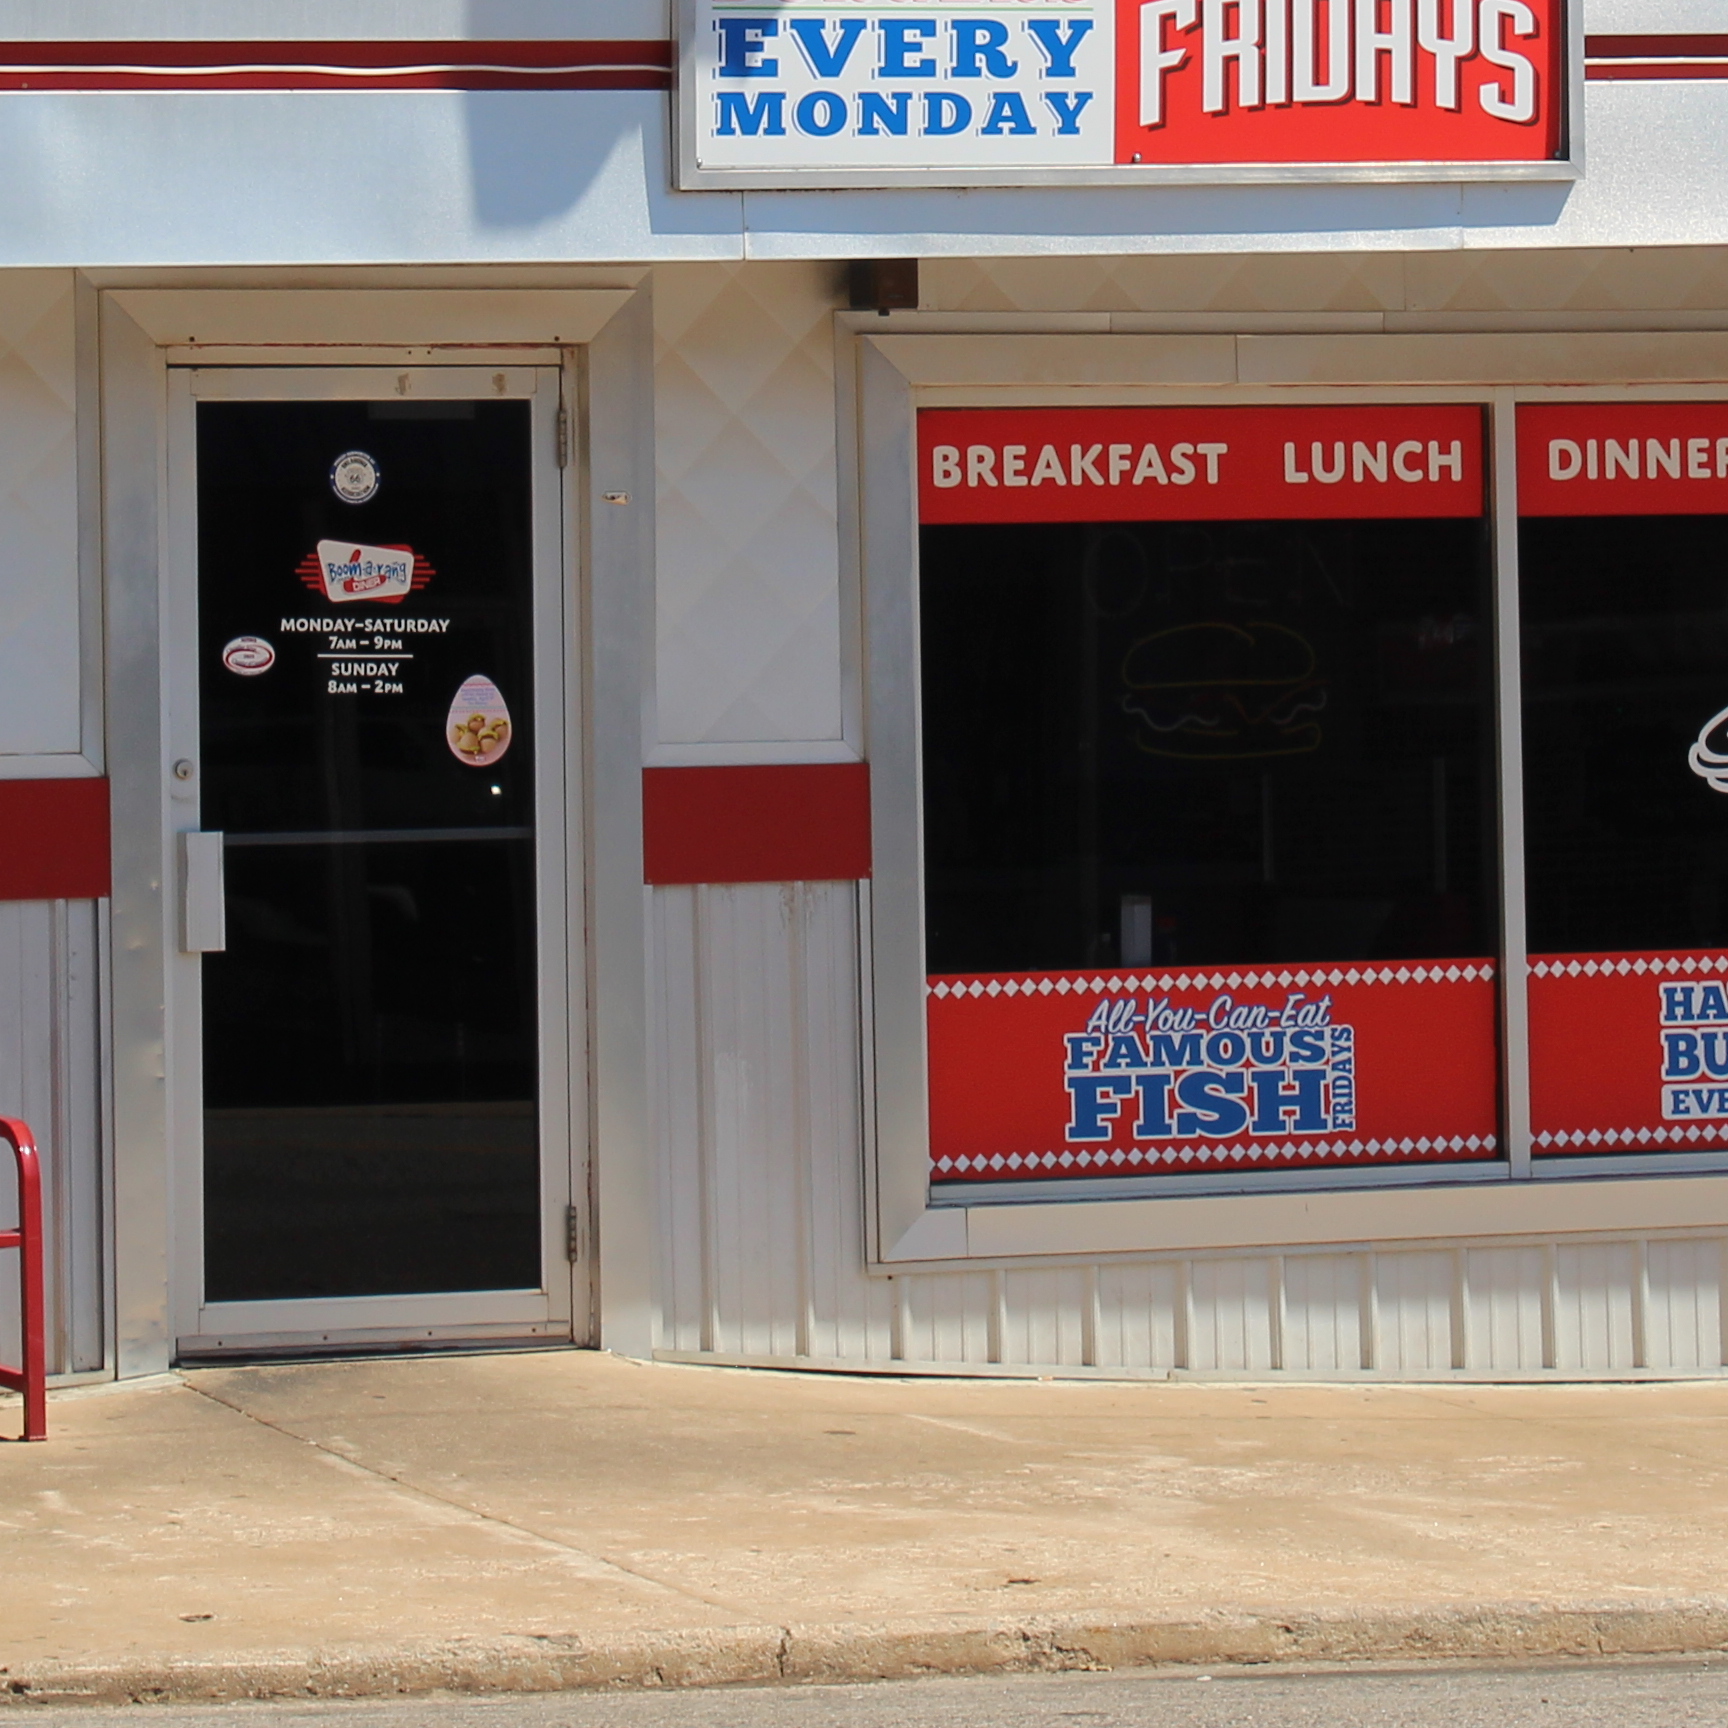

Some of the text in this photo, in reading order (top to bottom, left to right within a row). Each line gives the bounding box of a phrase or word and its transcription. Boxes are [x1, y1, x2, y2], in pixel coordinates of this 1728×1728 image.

[712, 18, 1095, 80] EVERY
[711, 91, 1095, 138] MONDAY
[932, 440, 1463, 488] BREAKFAST LUNCH
[328, 635, 357, 650] 7AM
[374, 635, 403, 650] 9PM
[327, 679, 358, 694] 8AM
[374, 679, 404, 694] 2PM
[331, 662, 399, 676] SUNDAY
[1086, 993, 1332, 1035] All-You-Can-Eat
[1066, 1028, 1328, 1071] FAMOUS
[1331, 1025, 1355, 1132] FRIDAYS
[1067, 1069, 1329, 1140] FISH
